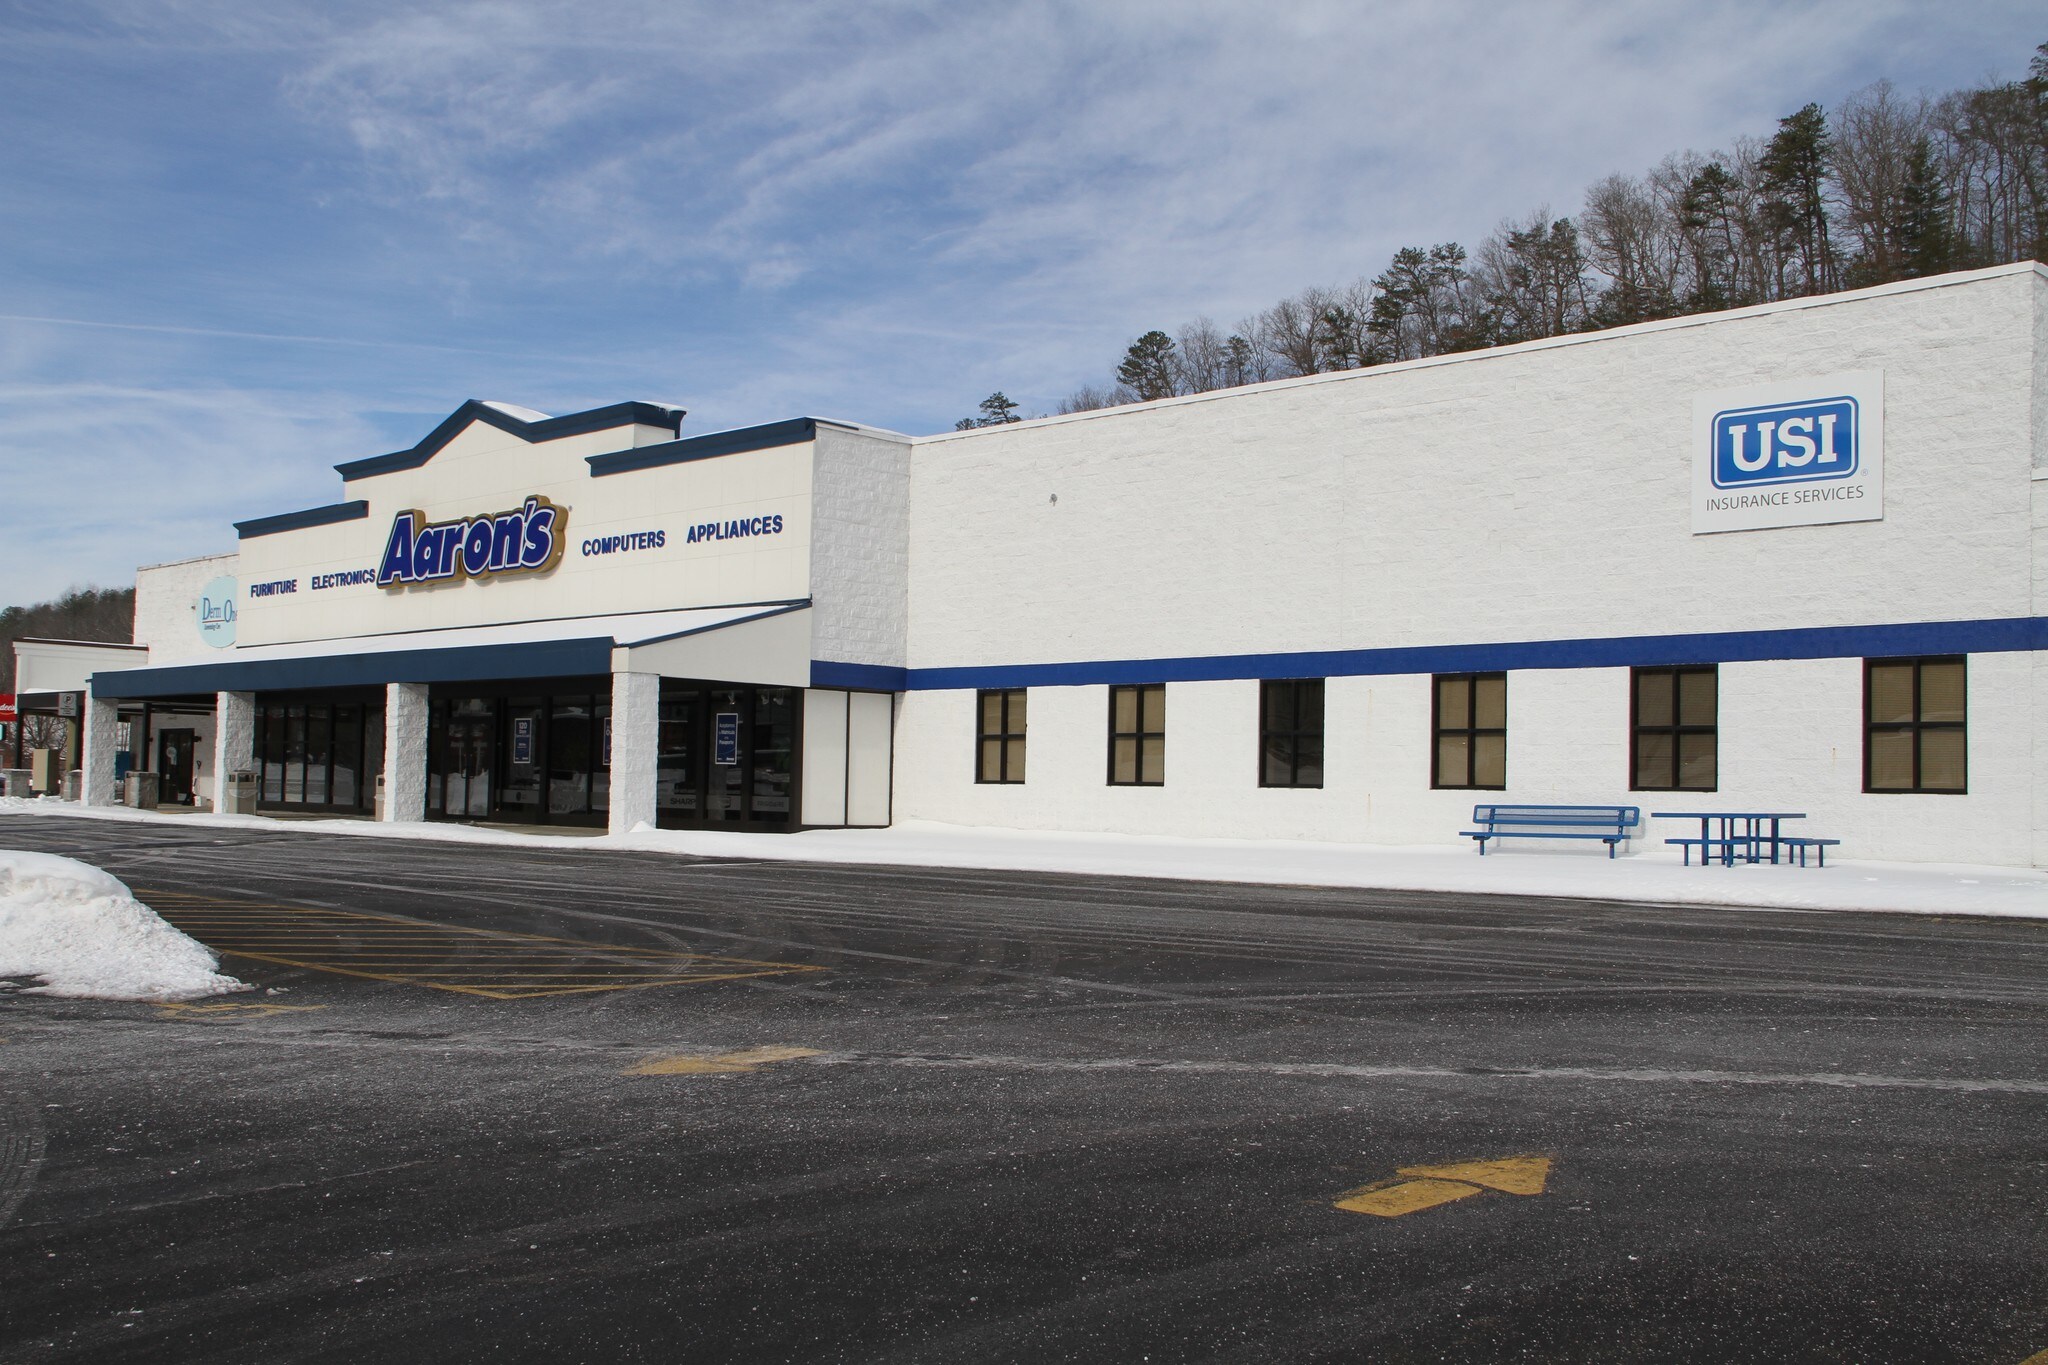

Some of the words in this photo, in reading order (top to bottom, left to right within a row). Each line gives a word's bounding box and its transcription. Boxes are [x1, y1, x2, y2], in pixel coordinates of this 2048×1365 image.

[1728, 413, 1838, 472] USI
[1706, 491, 1789, 511] INSURANCE
[1794, 485, 1864, 504] SERVICES
[377, 499, 557, 586] Aaron's
[581, 530, 666, 557] COMPUTERS
[686, 514, 783, 544] APPLIANCES
[250, 579, 298, 598] FURNITURE
[311, 568, 376, 590] ELECTRONICS
[670, 797, 697, 806] SHARP
